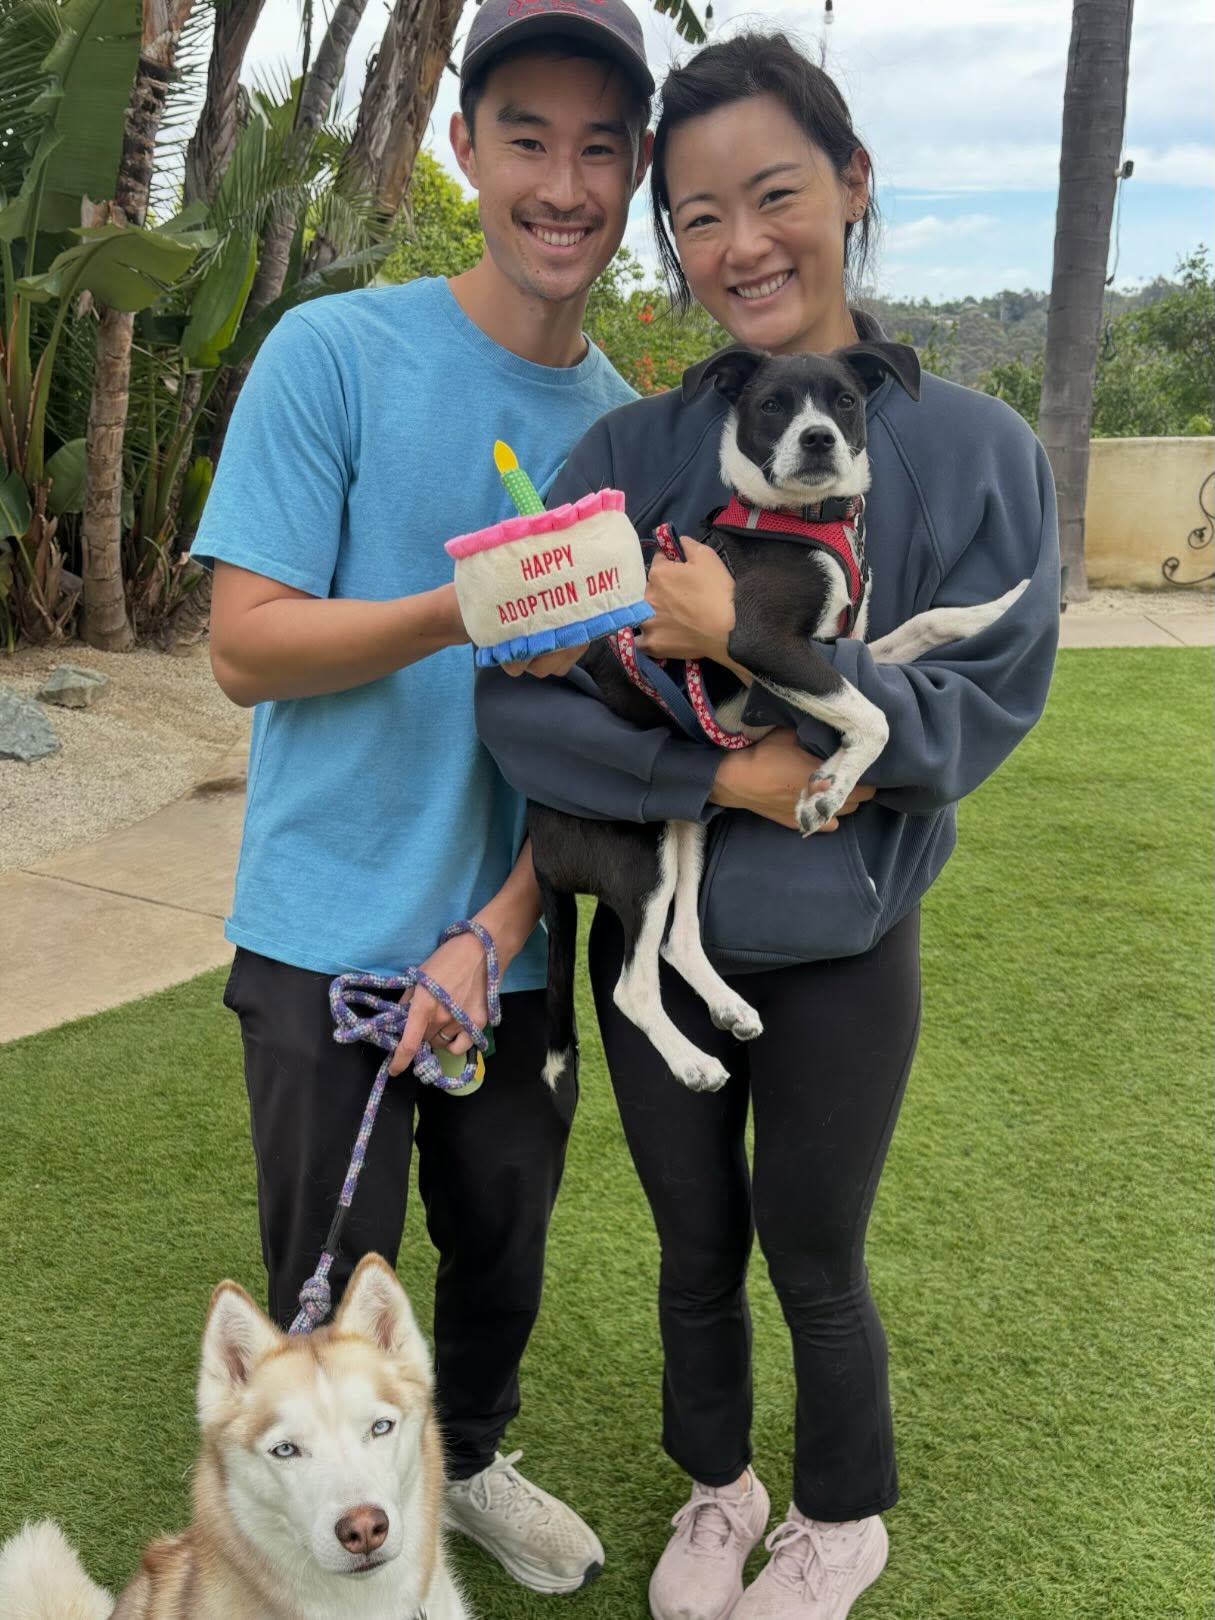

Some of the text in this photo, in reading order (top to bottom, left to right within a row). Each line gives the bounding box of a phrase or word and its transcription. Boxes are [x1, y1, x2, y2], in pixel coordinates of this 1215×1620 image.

[521, 545, 574, 581] HAPPY
[497, 568, 620, 624] ADOPTION DAY!
